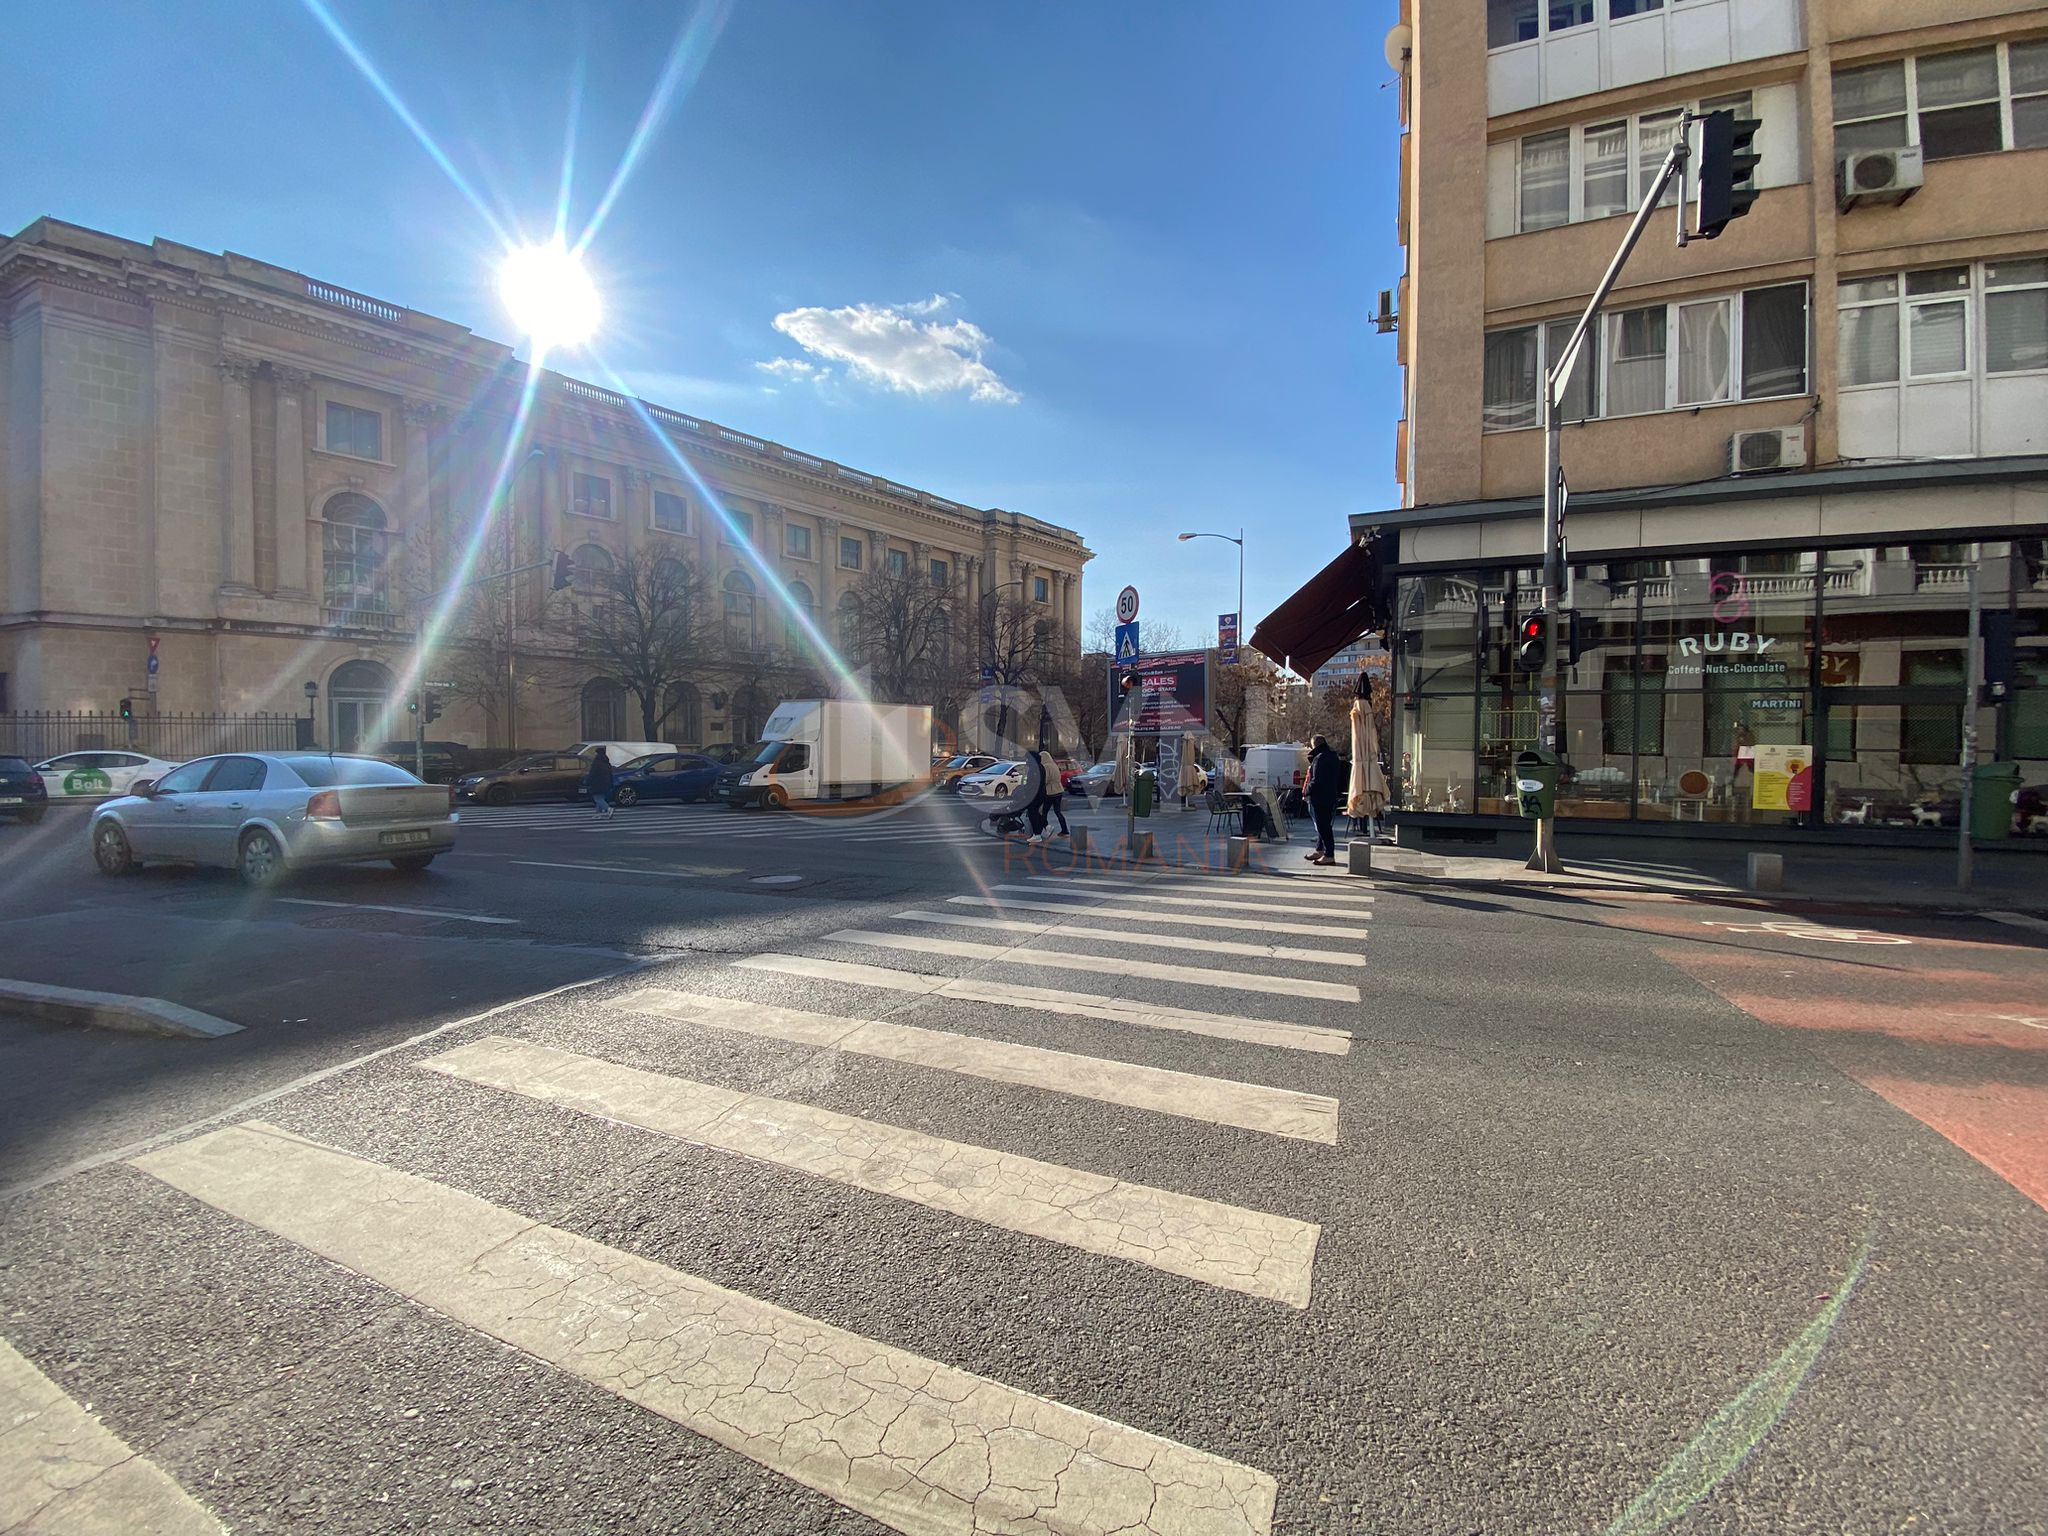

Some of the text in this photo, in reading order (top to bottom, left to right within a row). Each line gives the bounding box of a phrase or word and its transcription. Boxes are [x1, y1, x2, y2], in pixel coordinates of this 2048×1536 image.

[1121, 595, 1133, 614] 50
[1678, 632, 1776, 657] RUBY
[1141, 677, 1175, 688] SALES
[1752, 699, 1801, 709] MARTINI
[72, 778, 104, 791] Bolt
